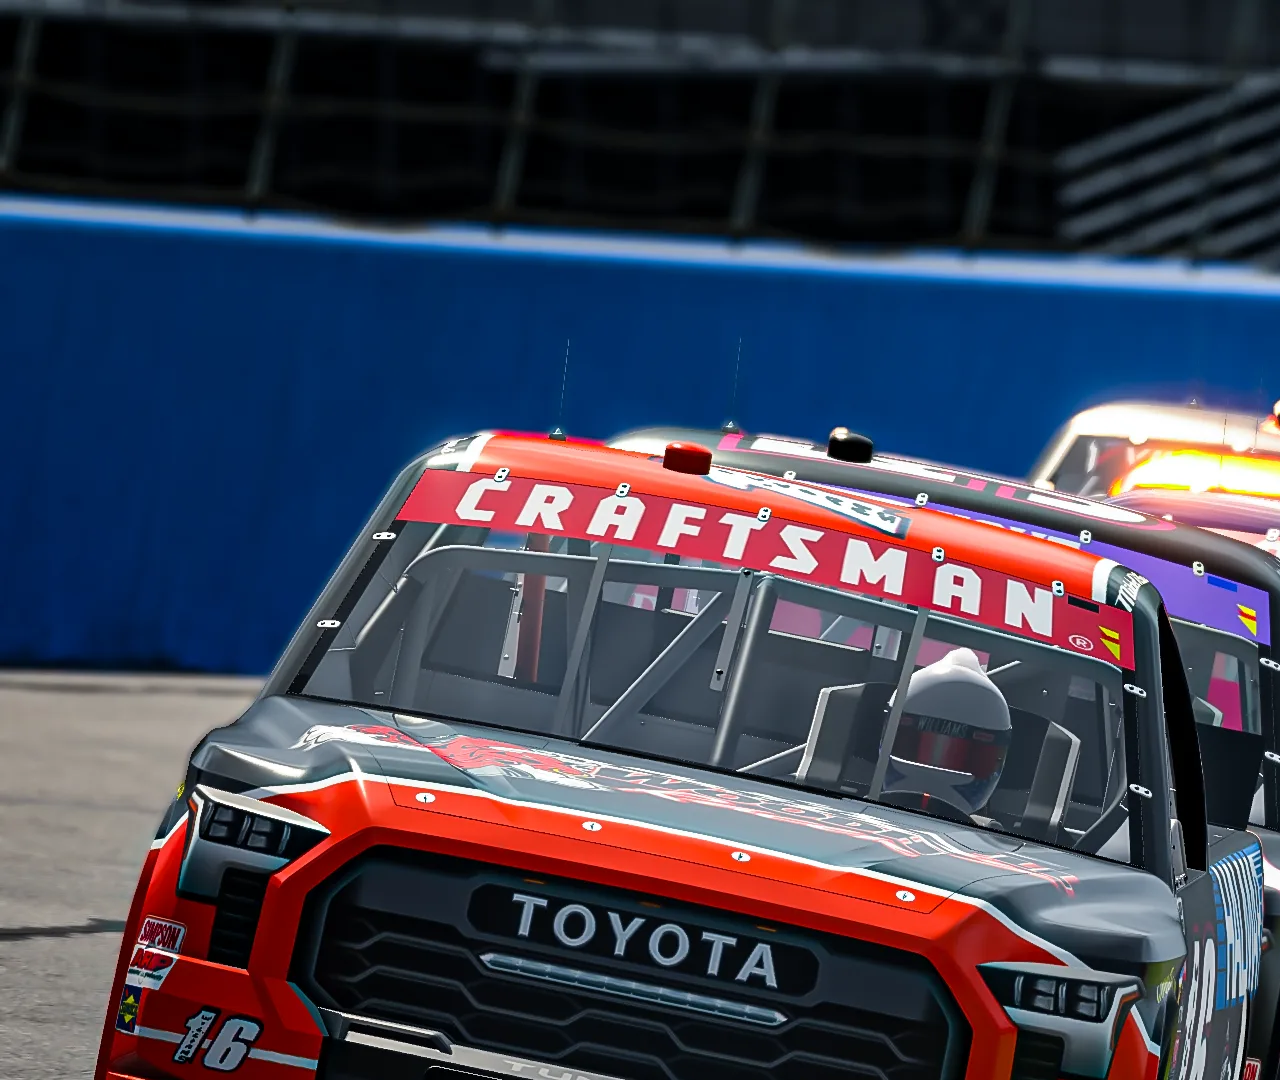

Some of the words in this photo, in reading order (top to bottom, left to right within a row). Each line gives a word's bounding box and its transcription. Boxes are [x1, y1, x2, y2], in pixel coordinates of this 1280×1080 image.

[454, 479, 1054, 638] CRAFTSMAN
[131, 948, 174, 972] ARP
[140, 920, 182, 950] SIMPSON
[511, 893, 778, 989] TOYOTA
[173, 1008, 262, 1071] 16
